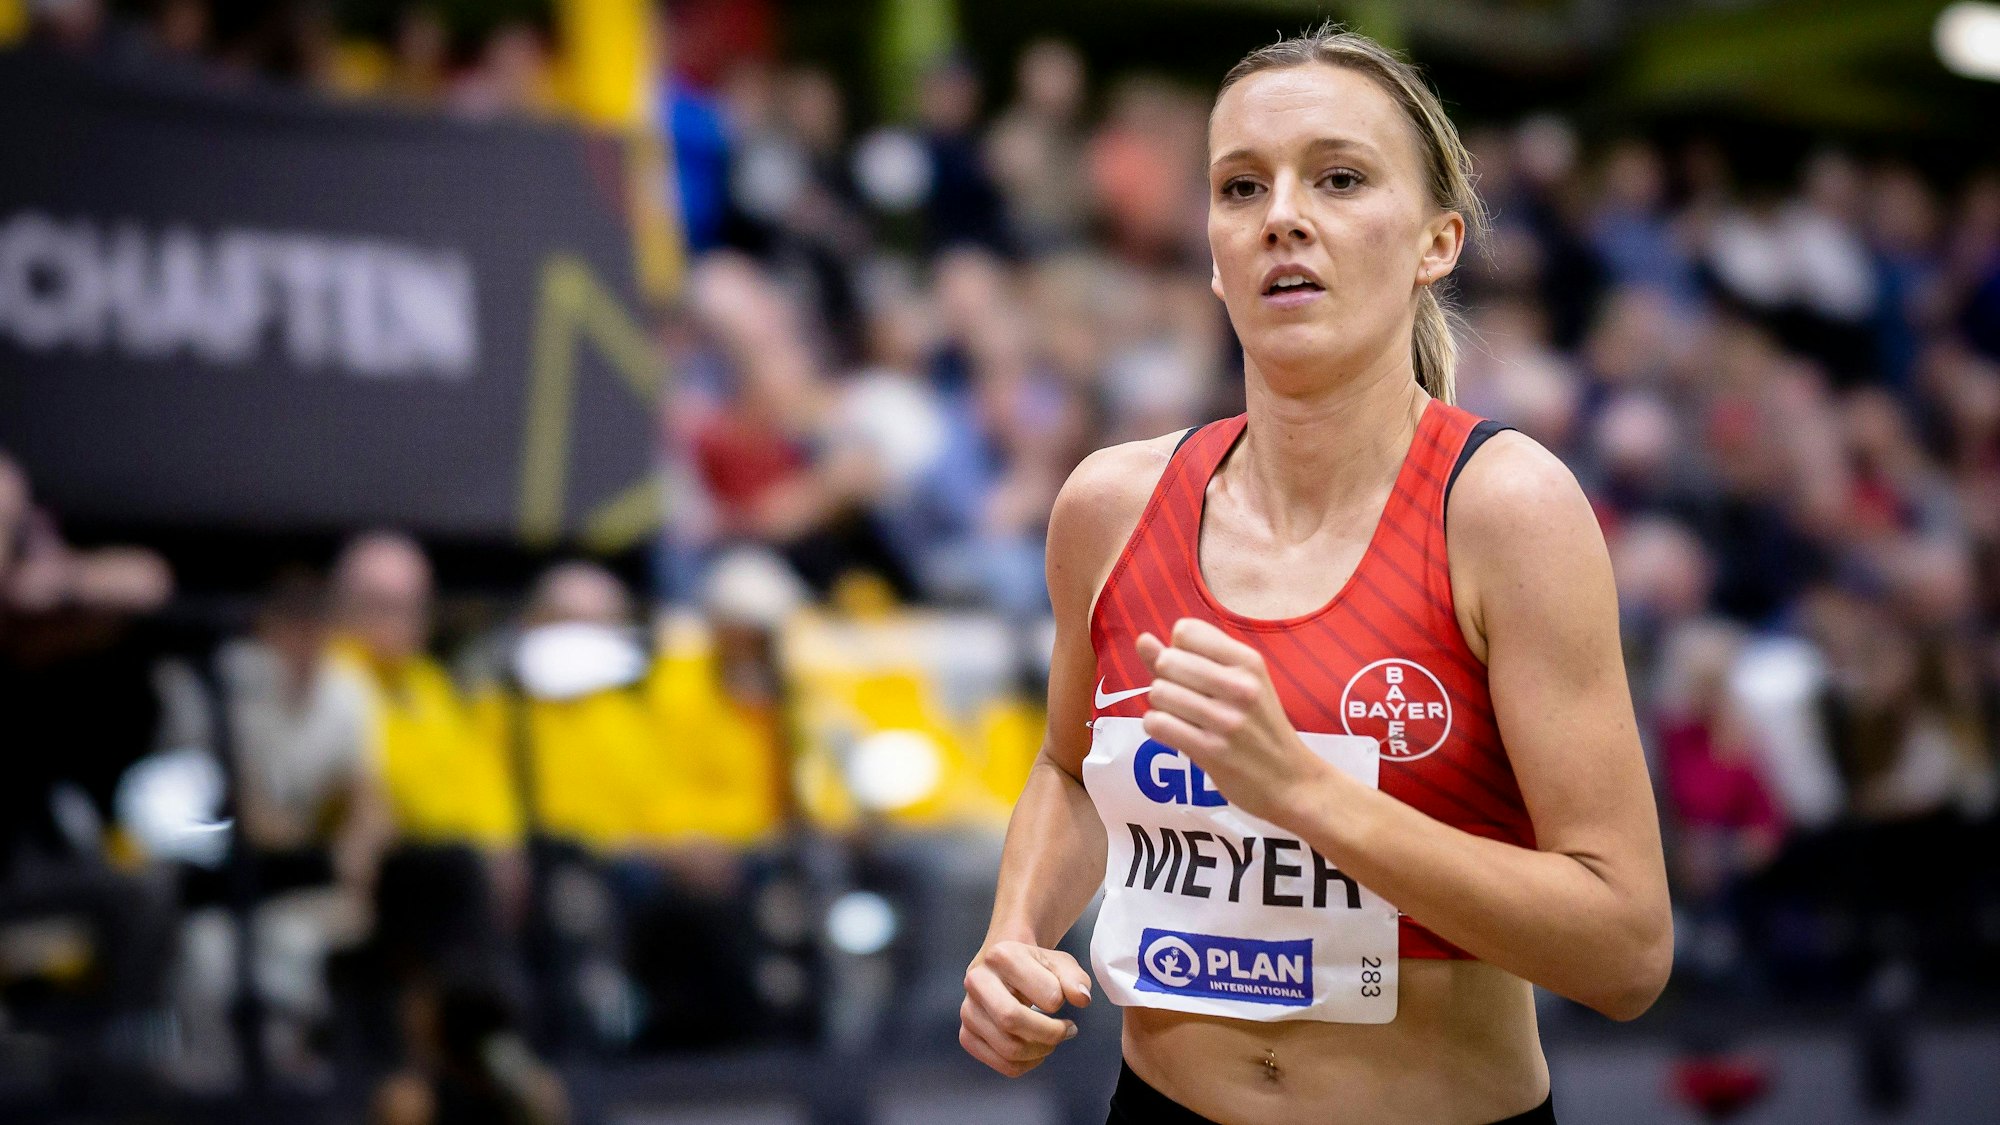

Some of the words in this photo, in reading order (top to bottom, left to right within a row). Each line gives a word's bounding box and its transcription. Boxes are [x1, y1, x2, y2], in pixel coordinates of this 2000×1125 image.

[1348, 700, 1445, 720] BAYER
[1385, 666, 1411, 755] BAYER
[1125, 823, 1362, 909] MEYER
[1206, 947, 1304, 984] PLAN
[1361, 956, 1382, 997] 283
[1210, 981, 1305, 998] INTERNATIONAL
